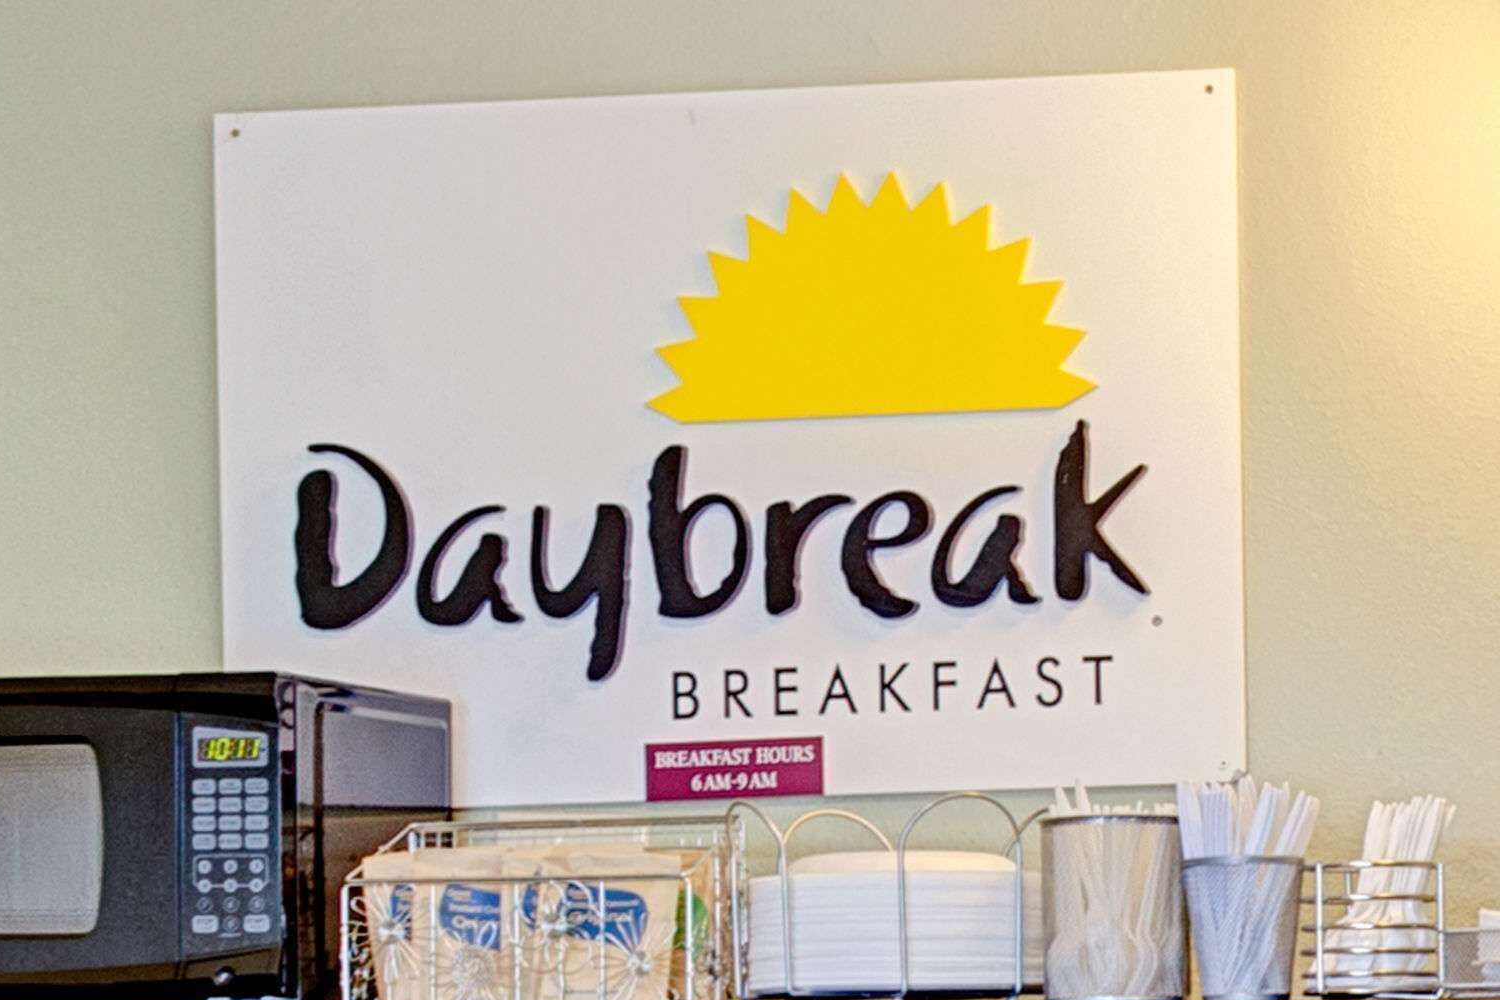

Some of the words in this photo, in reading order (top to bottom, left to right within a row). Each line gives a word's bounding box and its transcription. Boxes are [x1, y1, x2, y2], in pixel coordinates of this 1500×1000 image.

[295, 420, 1151, 683] Daybreak
[671, 655, 1114, 721] BREAKFAST
[654, 749, 752, 769] BREAKFAST
[755, 745, 814, 764] HOURS
